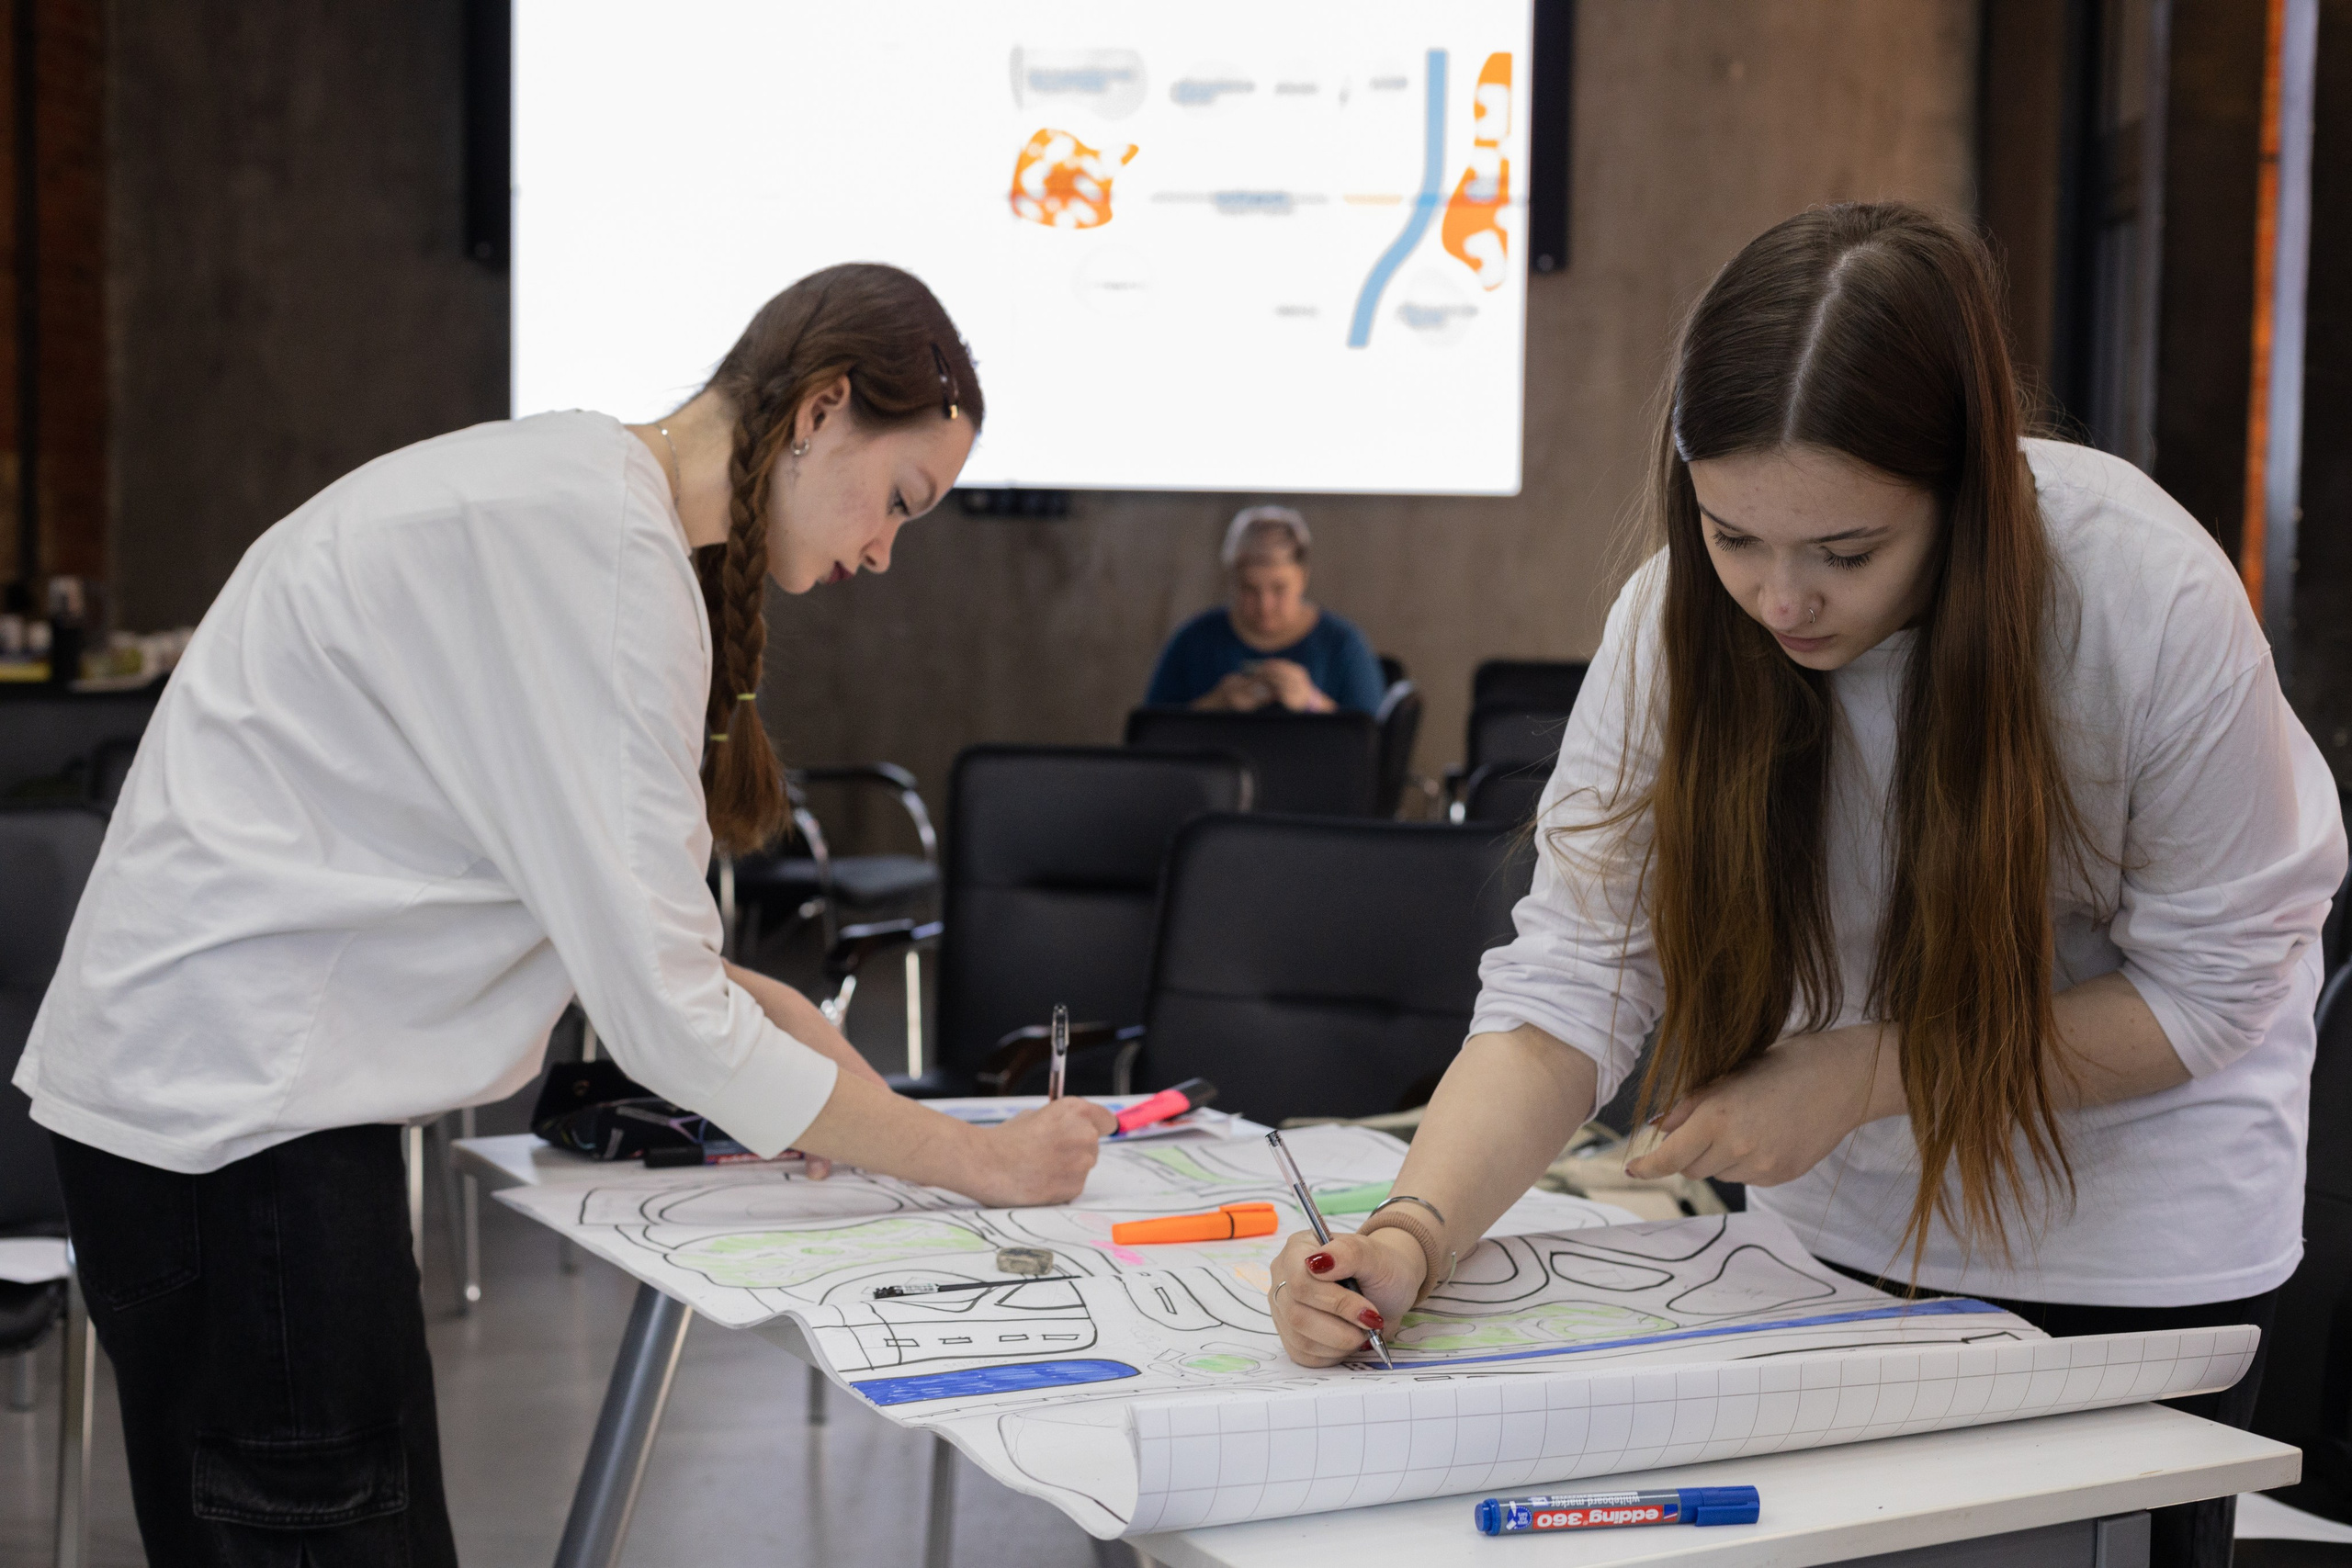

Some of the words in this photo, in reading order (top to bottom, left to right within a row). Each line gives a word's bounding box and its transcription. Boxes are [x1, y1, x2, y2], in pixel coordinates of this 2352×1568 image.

[1551, 1498, 1585, 1508] marker
[1588, 1495, 1640, 1507] whiteboard
[1537, 1513, 1583, 1527] 360
[1589, 1508, 1658, 1524] edding
